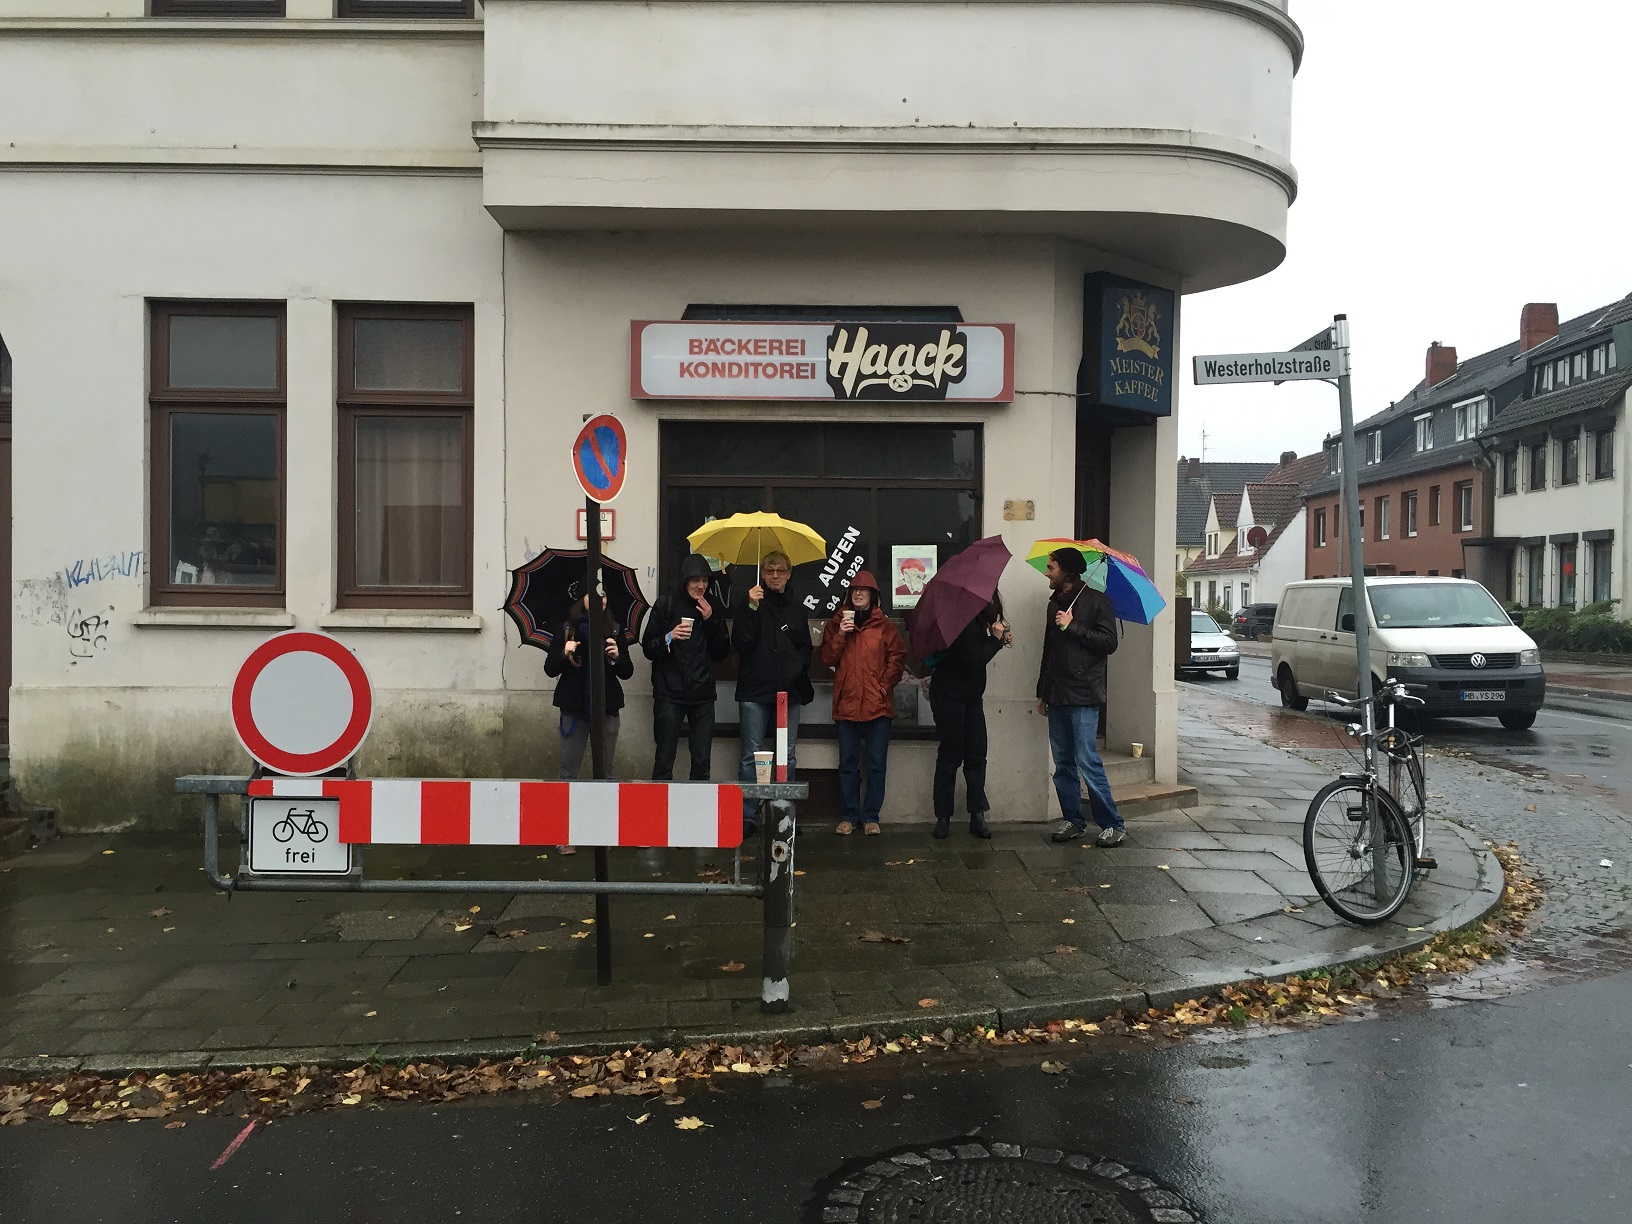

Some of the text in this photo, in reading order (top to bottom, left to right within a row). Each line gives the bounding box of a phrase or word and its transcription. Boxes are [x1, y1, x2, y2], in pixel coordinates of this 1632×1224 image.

[688, 338, 806, 356] BÄCKEREI
[679, 361, 816, 380] KONDITOREI
[828, 326, 966, 398] Haack
[1110, 358, 1165, 386] MEISTER
[1204, 355, 1331, 378] Westerholzstraße
[1115, 381, 1159, 402] KAFFEE
[818, 525, 861, 588] AUFEN
[826, 594, 841, 612] 94
[846, 555, 865, 578] 929
[1464, 692, 1475, 700] HB
[1490, 692, 1505, 700] 296
[285, 848, 315, 863] frei
